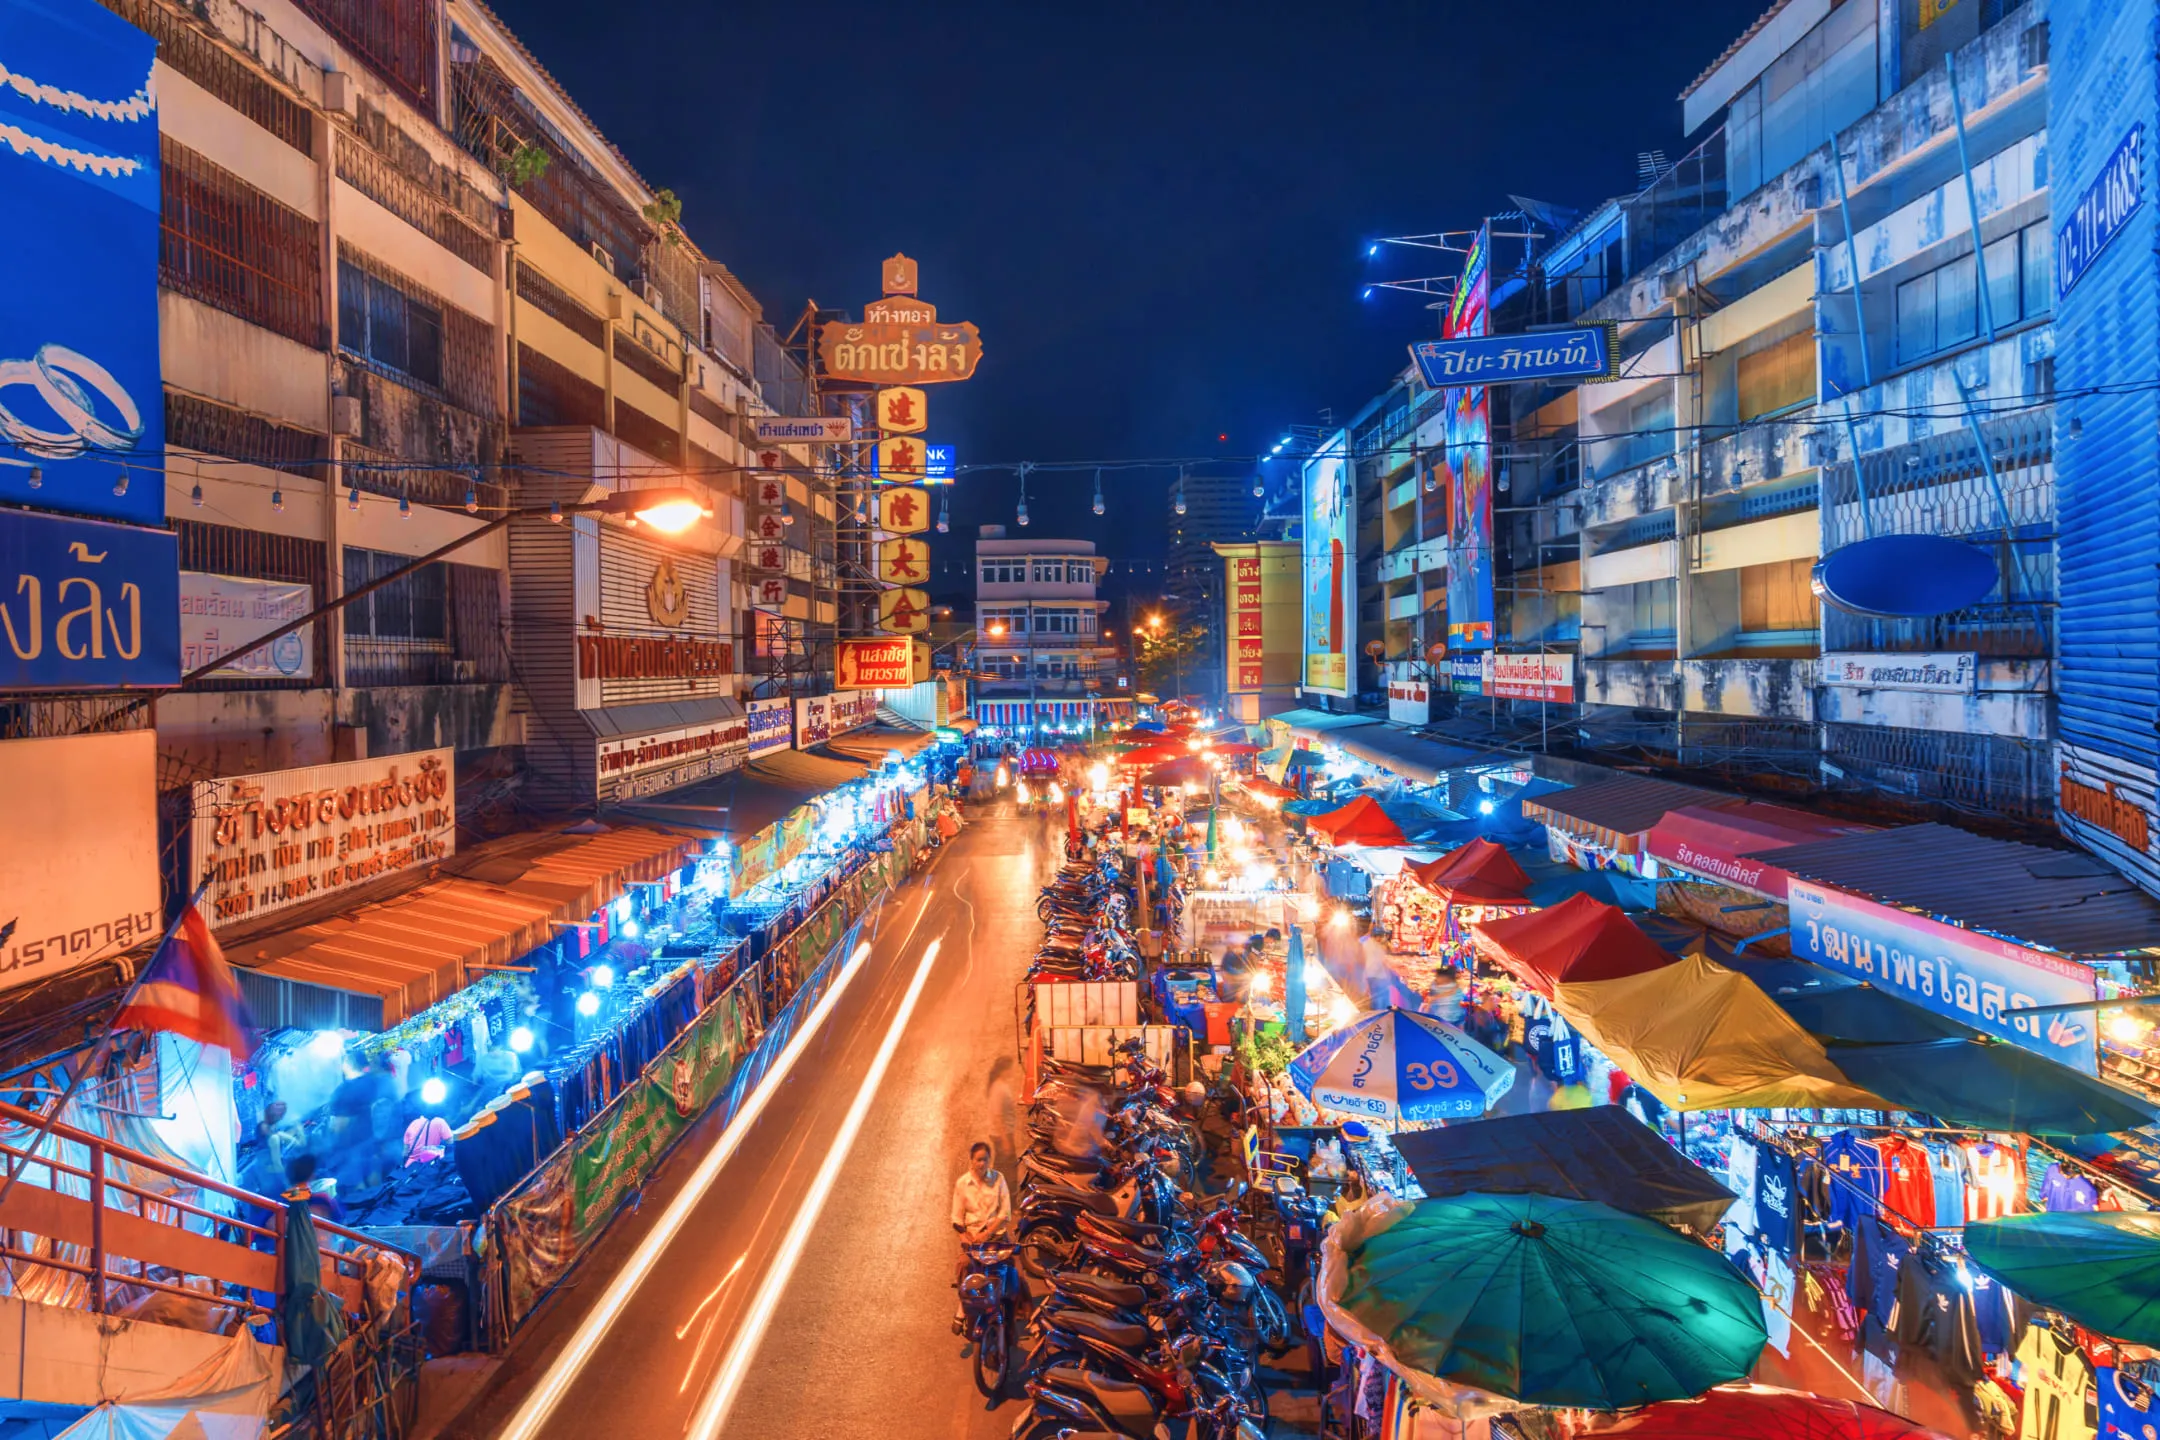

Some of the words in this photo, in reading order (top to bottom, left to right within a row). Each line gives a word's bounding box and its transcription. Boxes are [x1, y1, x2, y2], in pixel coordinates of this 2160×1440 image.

[2059, 130, 2139, 293] 02-711-1685
[869, 305, 931, 324] ห้างทอง
[861, 646, 907, 663] แสงชัย
[861, 667, 906, 681] เยาวราช
[1806, 910, 2041, 1038] วัฒนาพรโอสถ
[1405, 1060, 1459, 1091] 39
[1368, 1099, 1387, 1114] 39
[1455, 1100, 1473, 1112] 39
